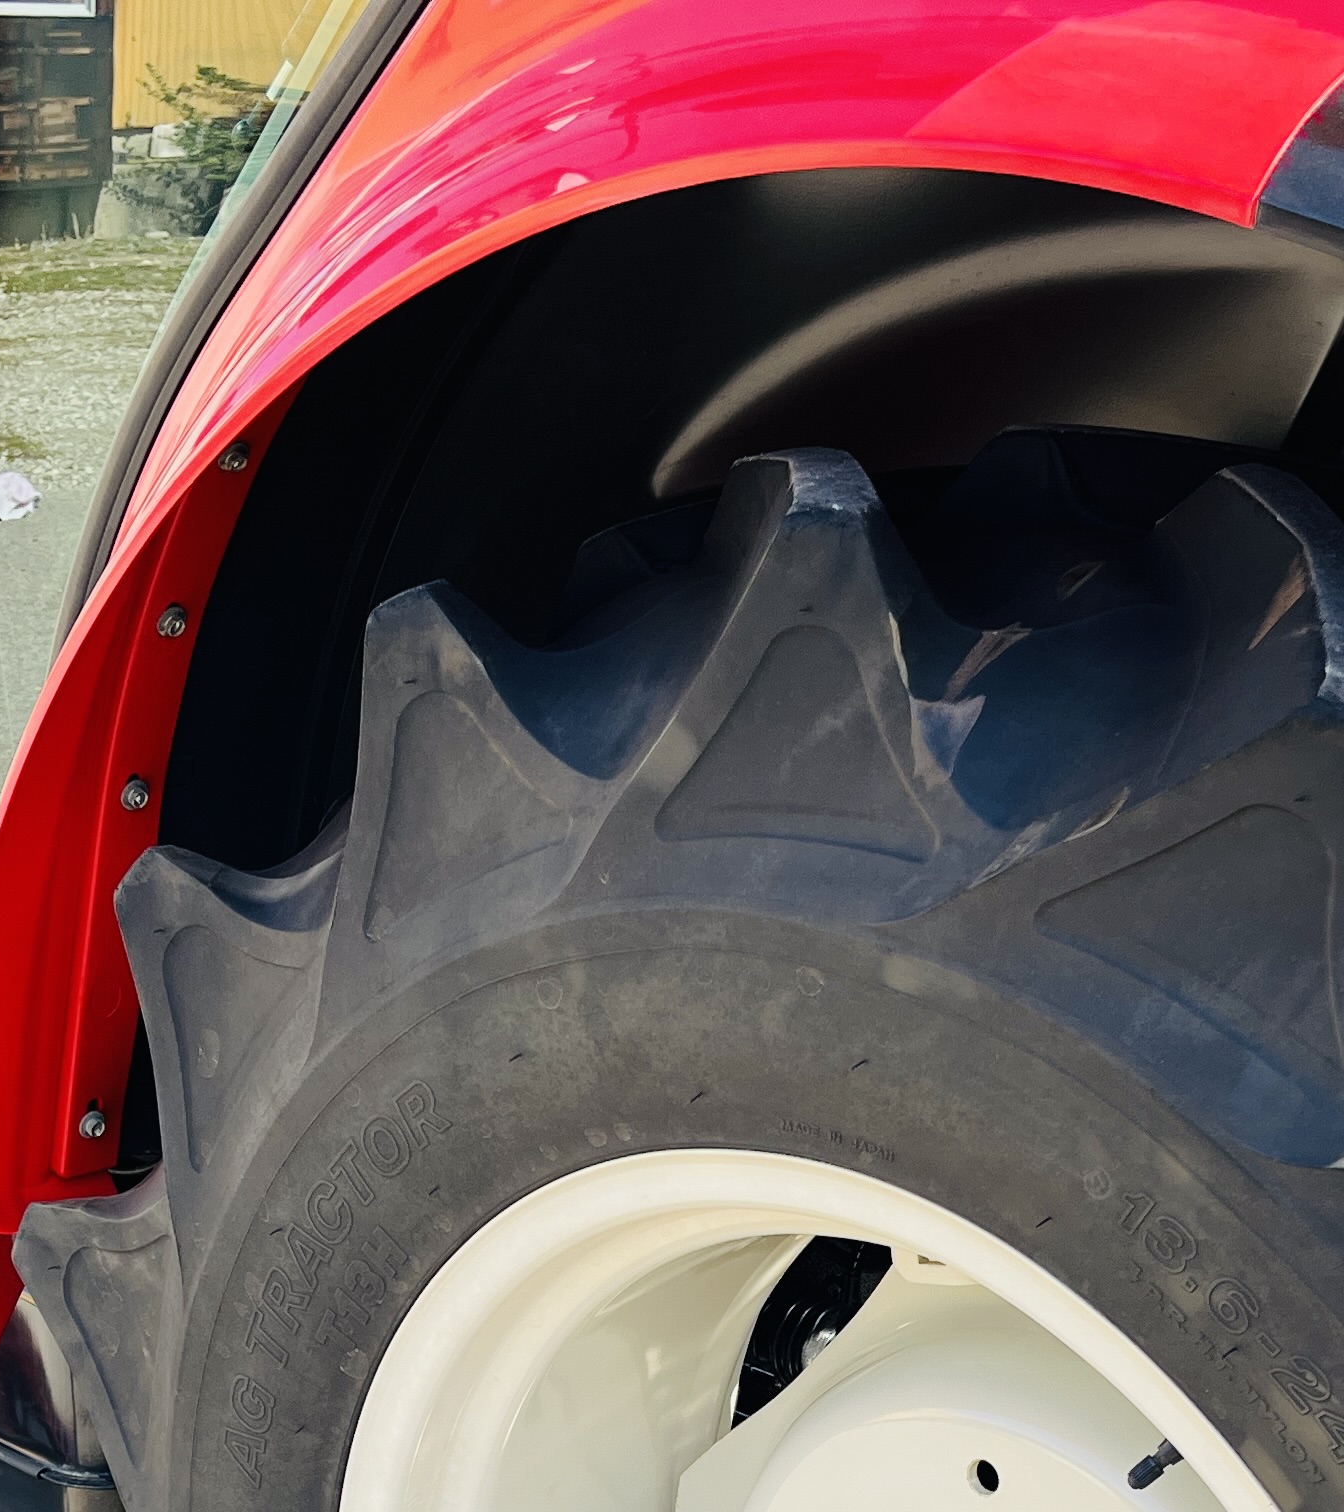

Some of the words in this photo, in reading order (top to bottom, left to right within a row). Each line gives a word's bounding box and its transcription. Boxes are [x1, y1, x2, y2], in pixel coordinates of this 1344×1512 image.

[780, 1117, 823, 1140] MADE
[852, 1137, 897, 1163] JAPAN
[244, 1079, 454, 1370] TRACTOR
[315, 1224, 414, 1354] T13H
[224, 1374, 277, 1488] AG
